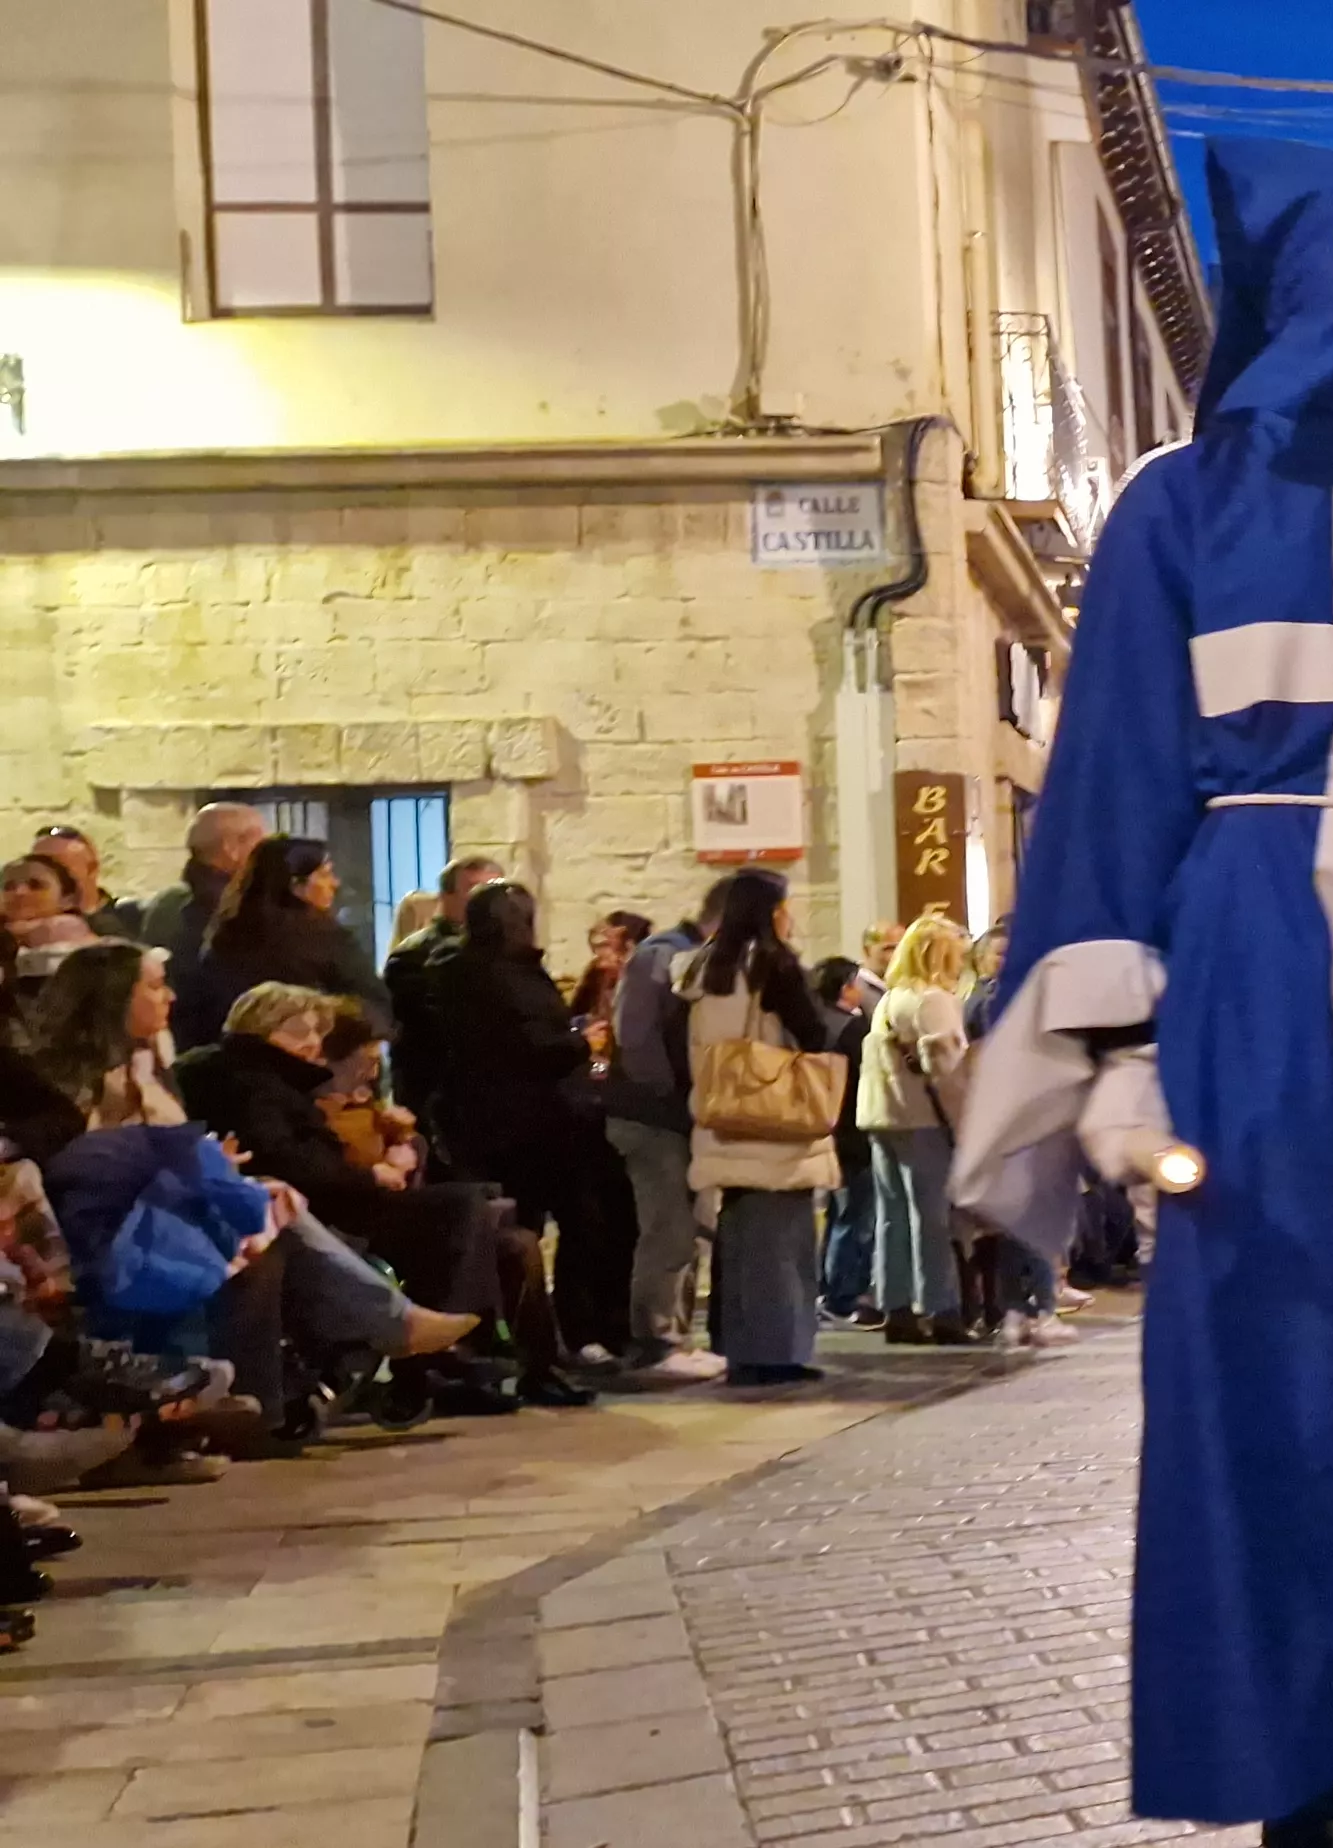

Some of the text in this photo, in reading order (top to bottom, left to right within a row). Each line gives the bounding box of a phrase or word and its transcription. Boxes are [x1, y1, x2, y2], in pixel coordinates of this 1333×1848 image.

[799, 496, 860, 514] CALLE
[762, 530, 875, 552] CASTILLA
[911, 785, 950, 876] BAR
